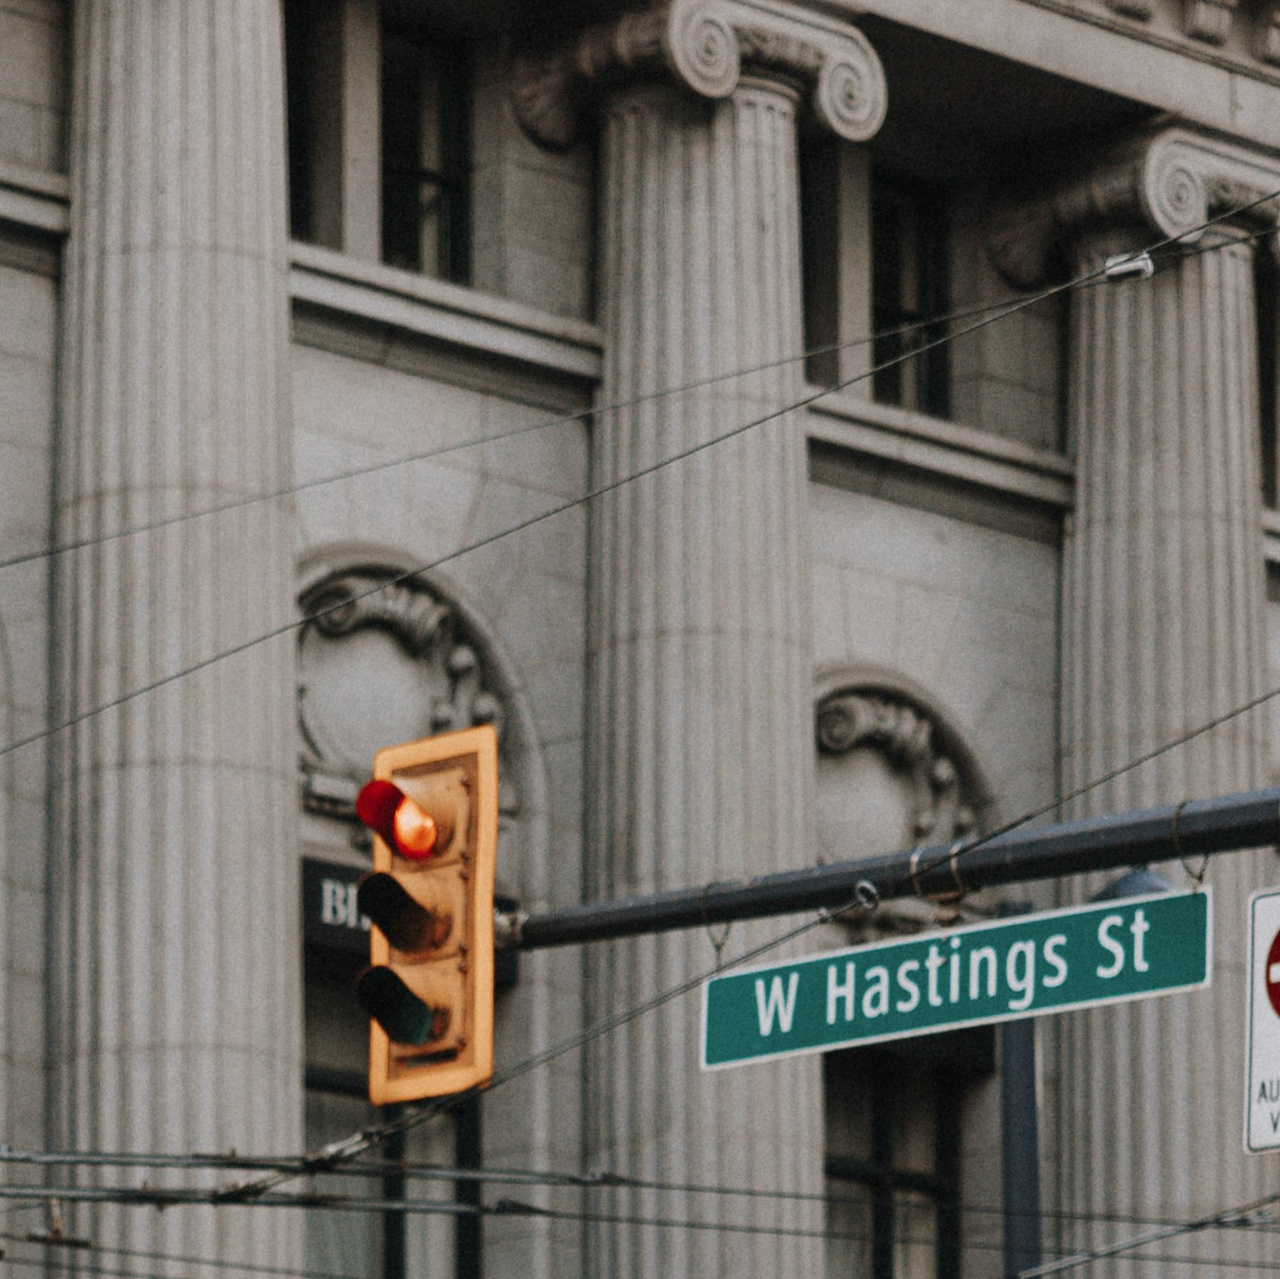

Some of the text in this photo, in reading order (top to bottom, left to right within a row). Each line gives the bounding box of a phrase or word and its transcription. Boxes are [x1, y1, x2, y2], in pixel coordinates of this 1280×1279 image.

[755, 908, 1151, 1037] W Hastings St
